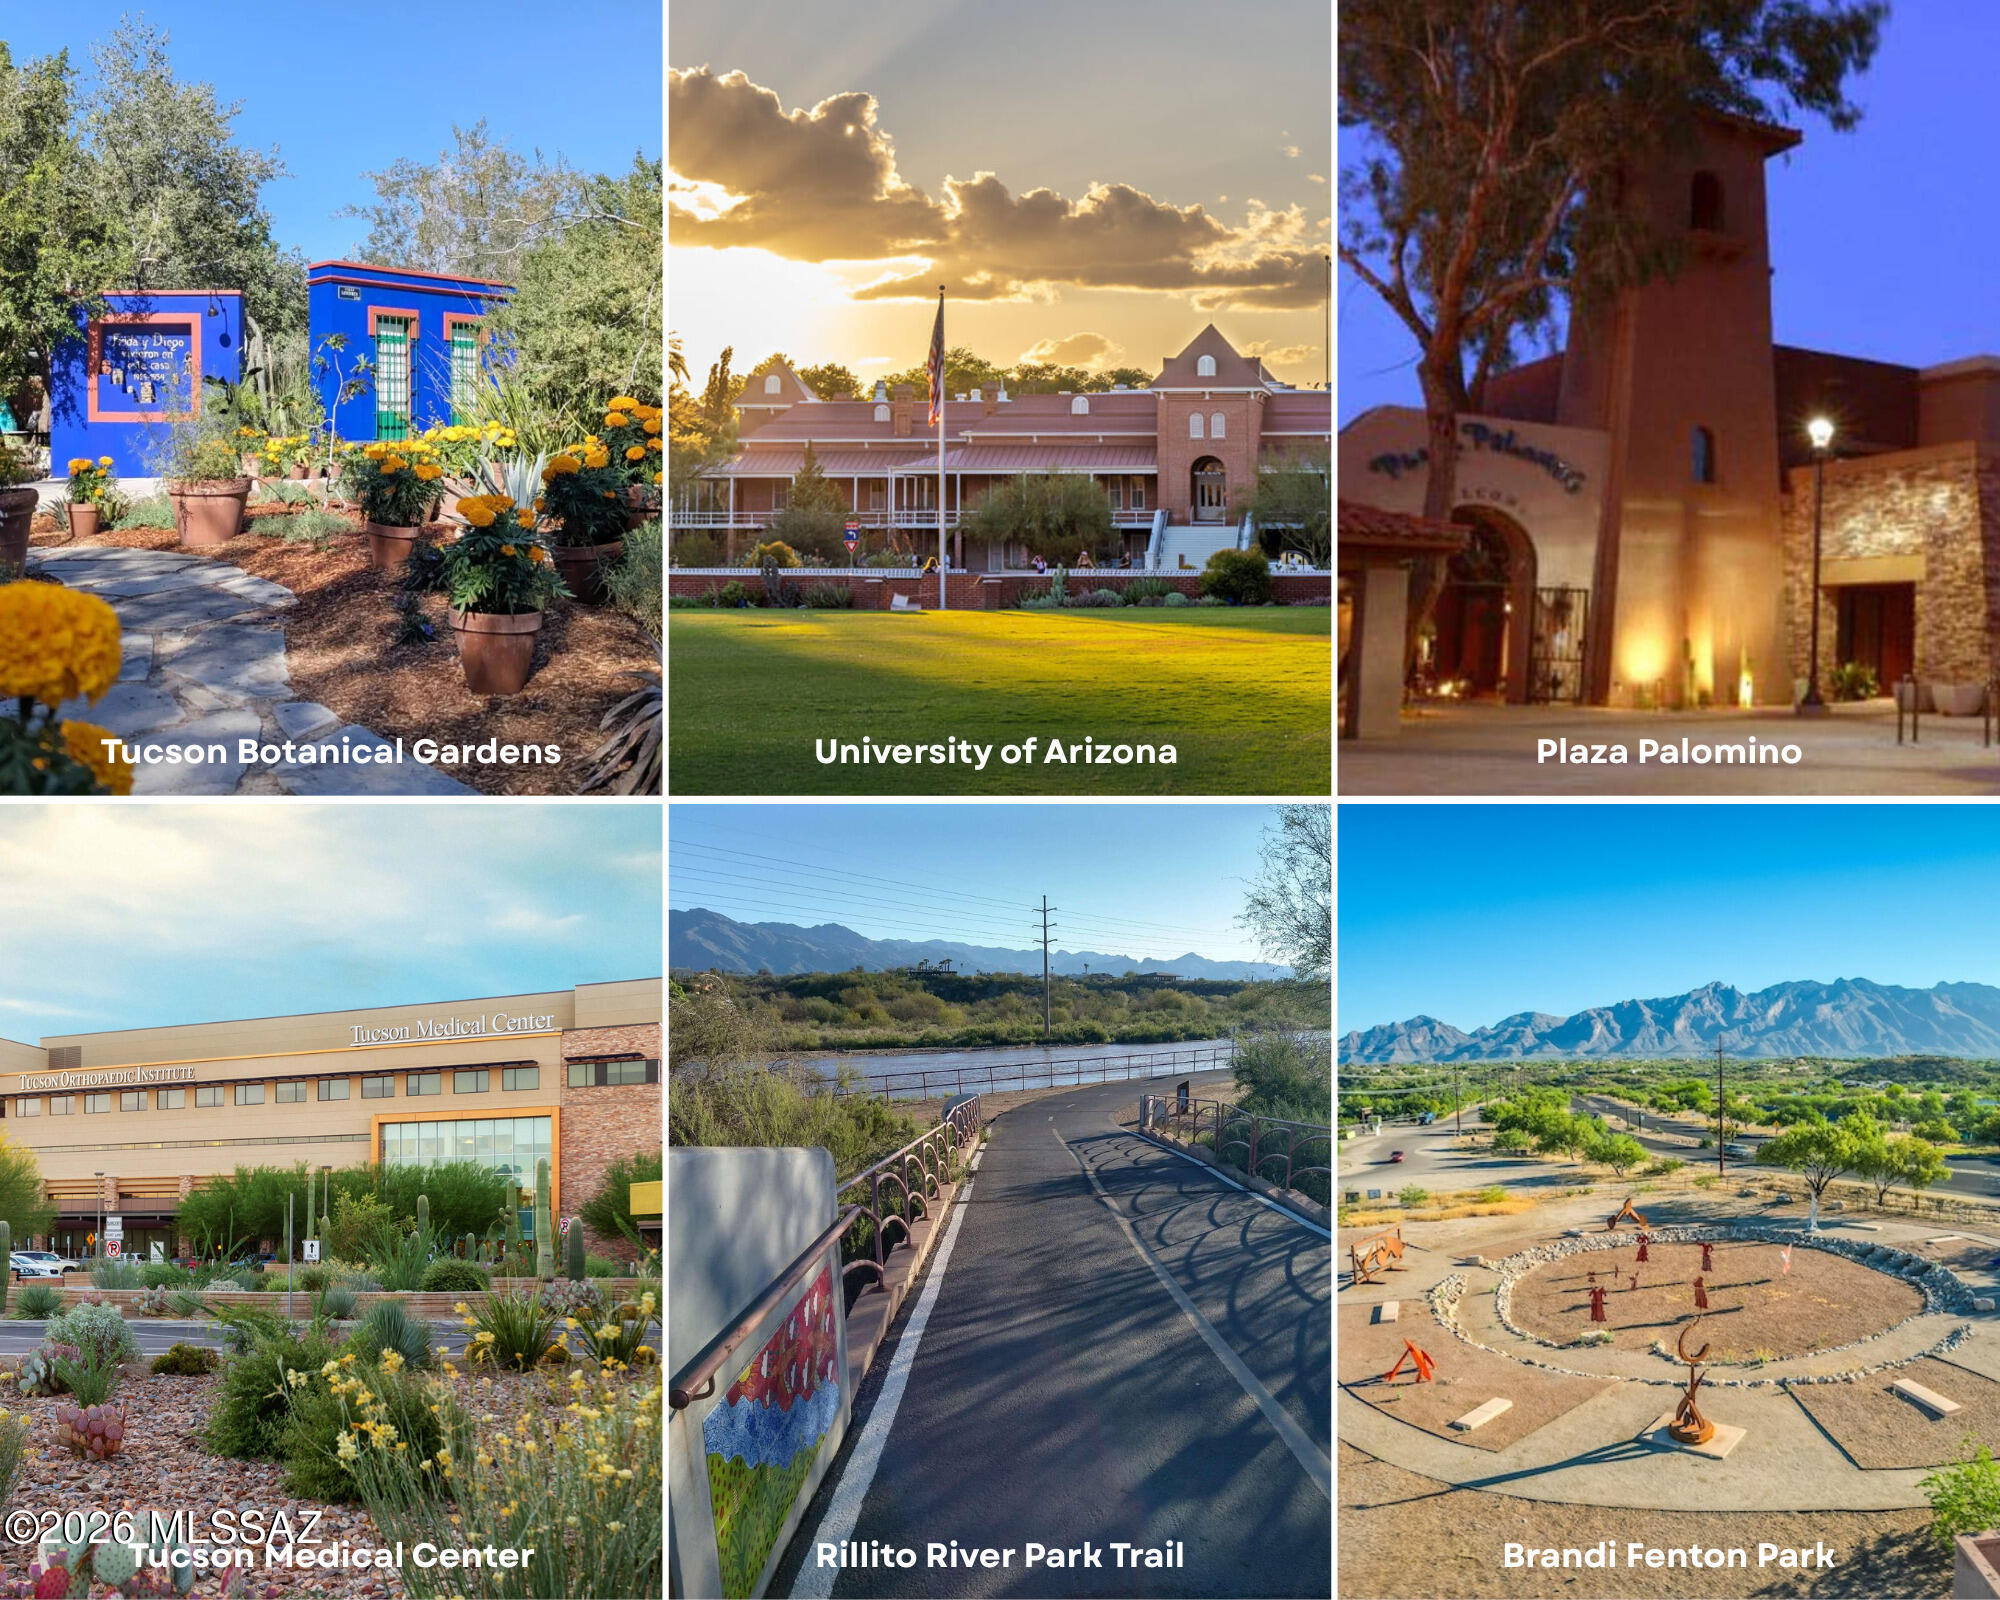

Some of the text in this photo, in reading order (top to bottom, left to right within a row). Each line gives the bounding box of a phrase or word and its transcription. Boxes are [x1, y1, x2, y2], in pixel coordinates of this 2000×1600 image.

[111, 332, 184, 351] Frida y Diego
[121, 349, 173, 359] vivieron en
[150, 362, 170, 370] casa
[350, 1012, 555, 1043] Tucson Medical Center
[19, 1066, 196, 1090] TUCSON ORTHOPAEDIC INSTITUTE
